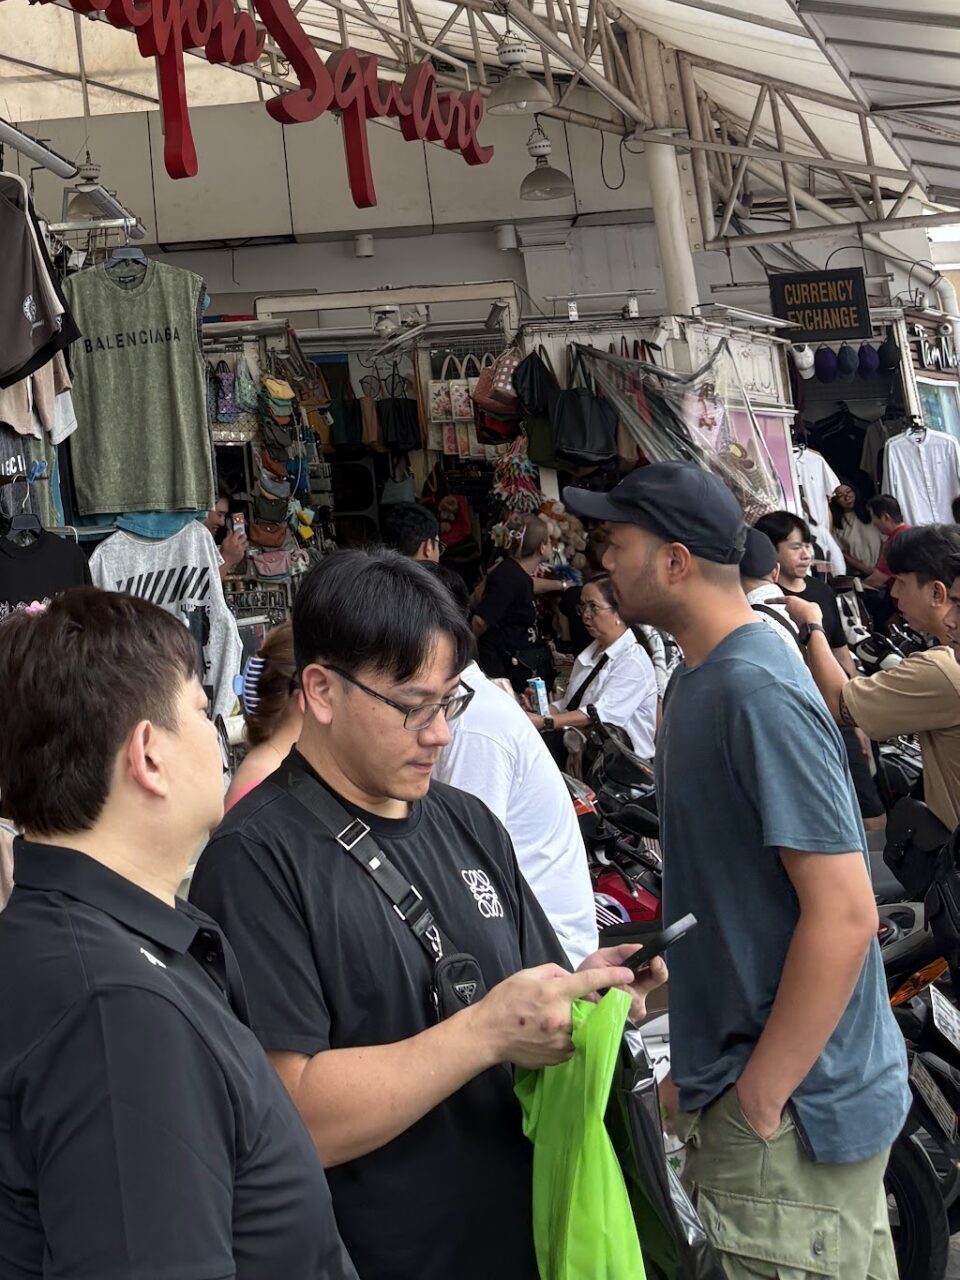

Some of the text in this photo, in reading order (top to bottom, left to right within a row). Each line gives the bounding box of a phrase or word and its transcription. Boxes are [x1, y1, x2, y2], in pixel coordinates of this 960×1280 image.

[784, 279, 854, 306] CURRENCY
[787, 307, 860, 332] EXCHANGE
[84, 327, 181, 353] BALENCIAGA
